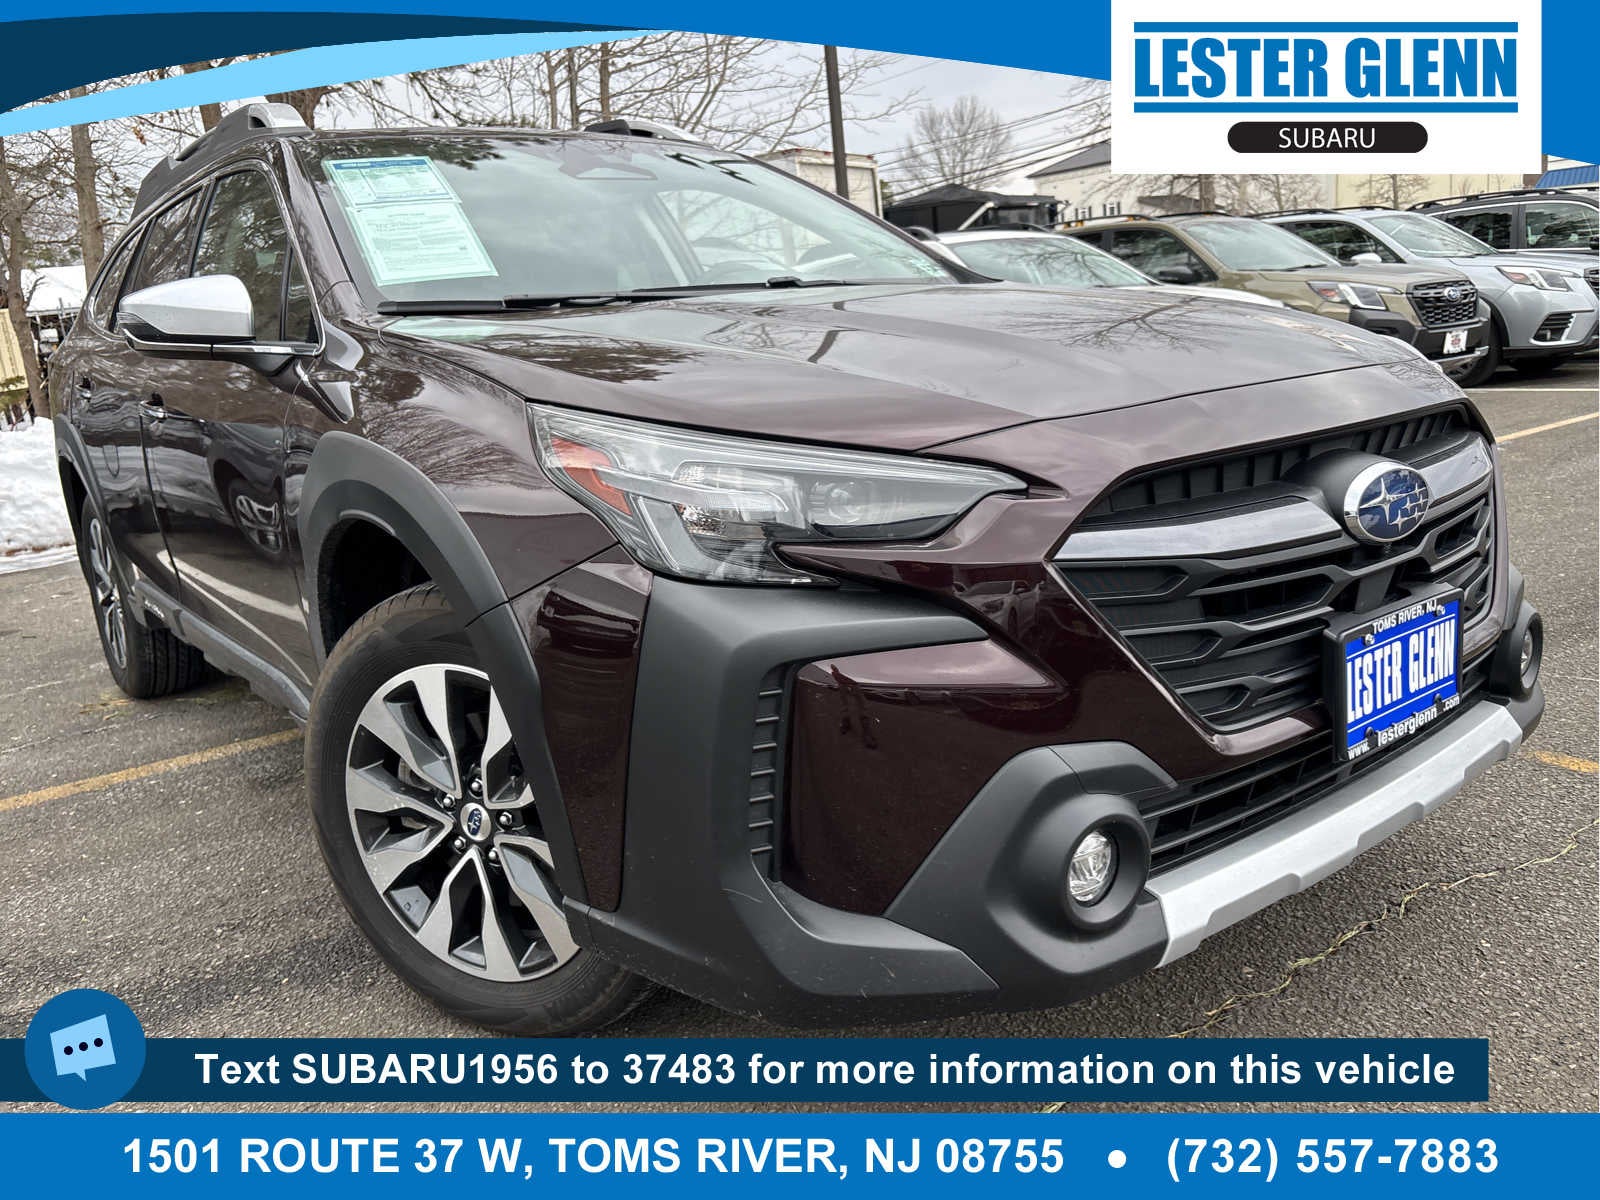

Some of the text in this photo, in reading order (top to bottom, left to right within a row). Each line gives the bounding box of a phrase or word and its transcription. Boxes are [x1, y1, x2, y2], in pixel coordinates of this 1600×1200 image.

[1373, 599, 1437, 634] TOMS RIVER, NJ
[1346, 619, 1456, 724] LESTER GLENN
[1376, 706, 1438, 747] lesterglenn
